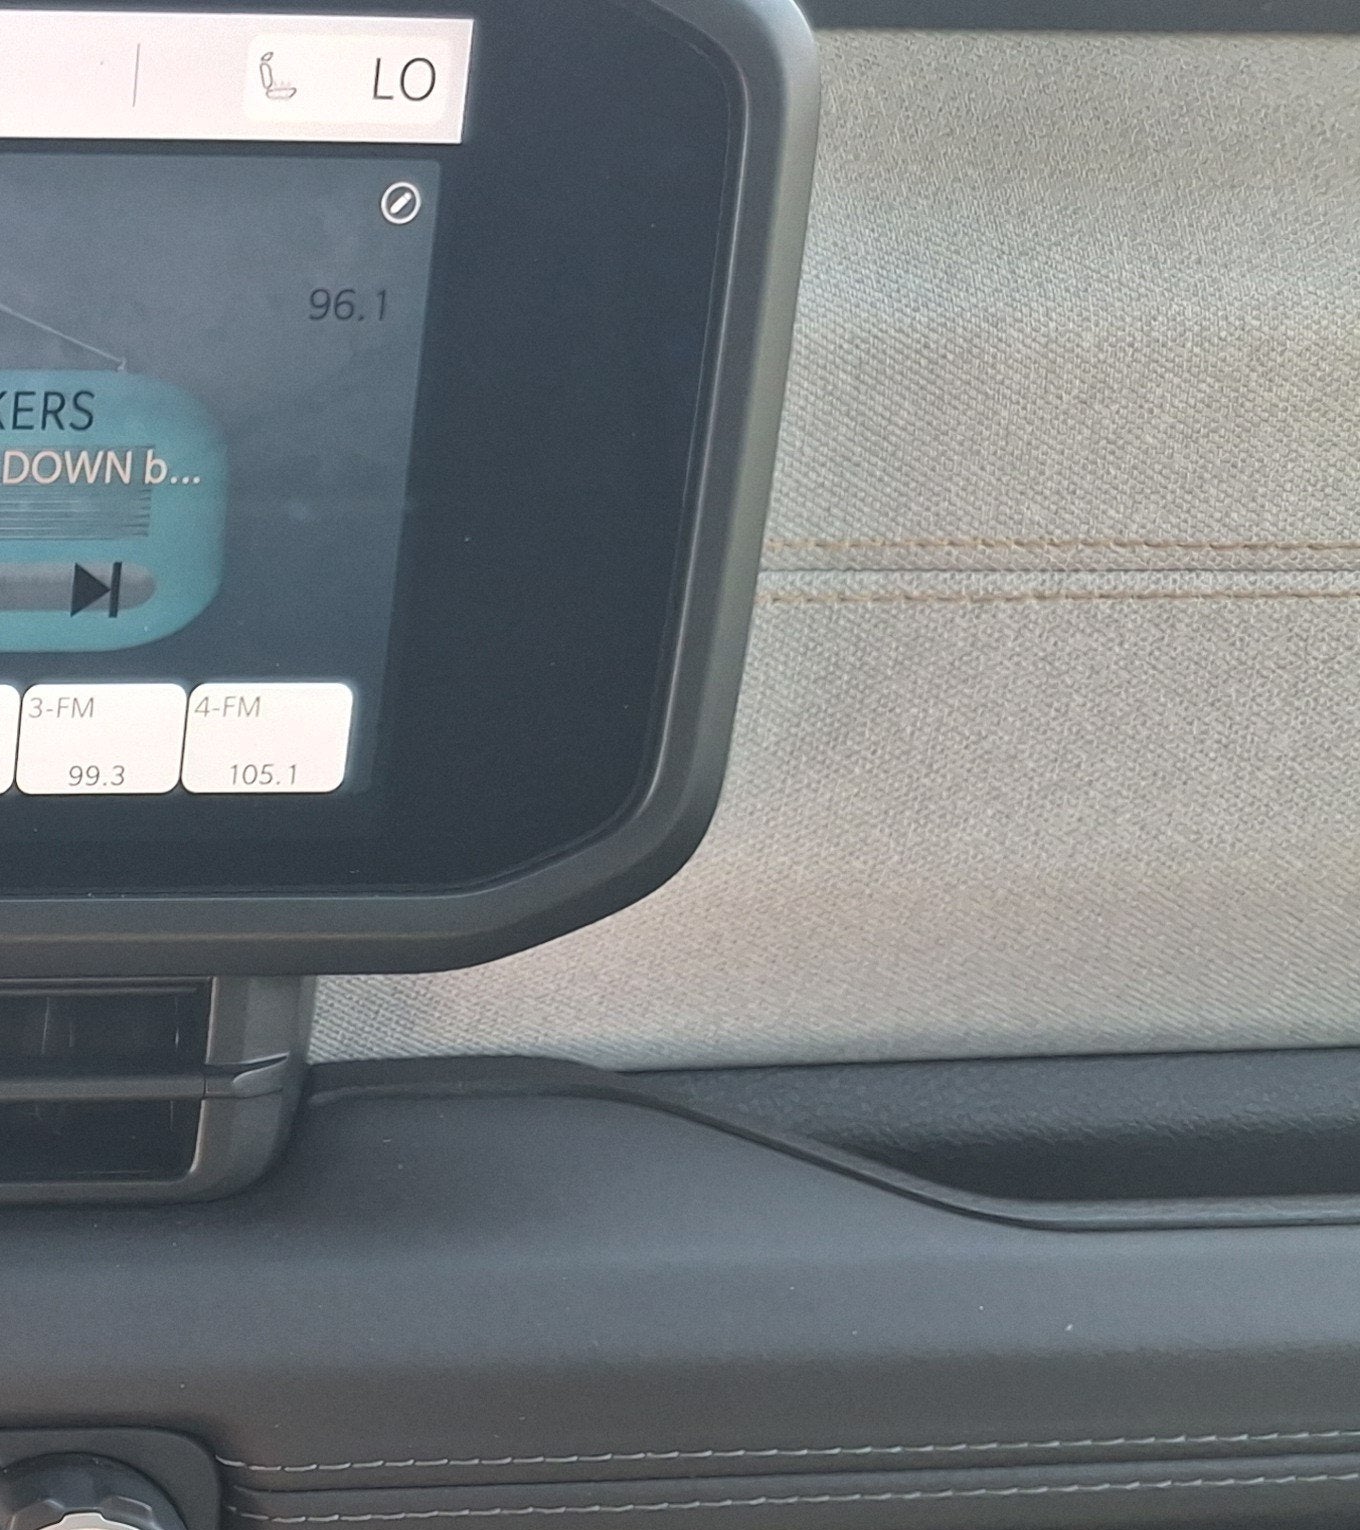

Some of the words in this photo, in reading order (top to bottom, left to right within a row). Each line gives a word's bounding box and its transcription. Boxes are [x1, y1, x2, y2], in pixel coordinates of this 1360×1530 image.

[373, 56, 437, 102] LO
[307, 287, 389, 323] 96.1
[2, 449, 133, 486] DOWN
[28, 697, 95, 719] 3-FM
[194, 696, 261, 718] 4-FM
[68, 764, 126, 788] 99.3
[230, 763, 298, 787] 105.1
